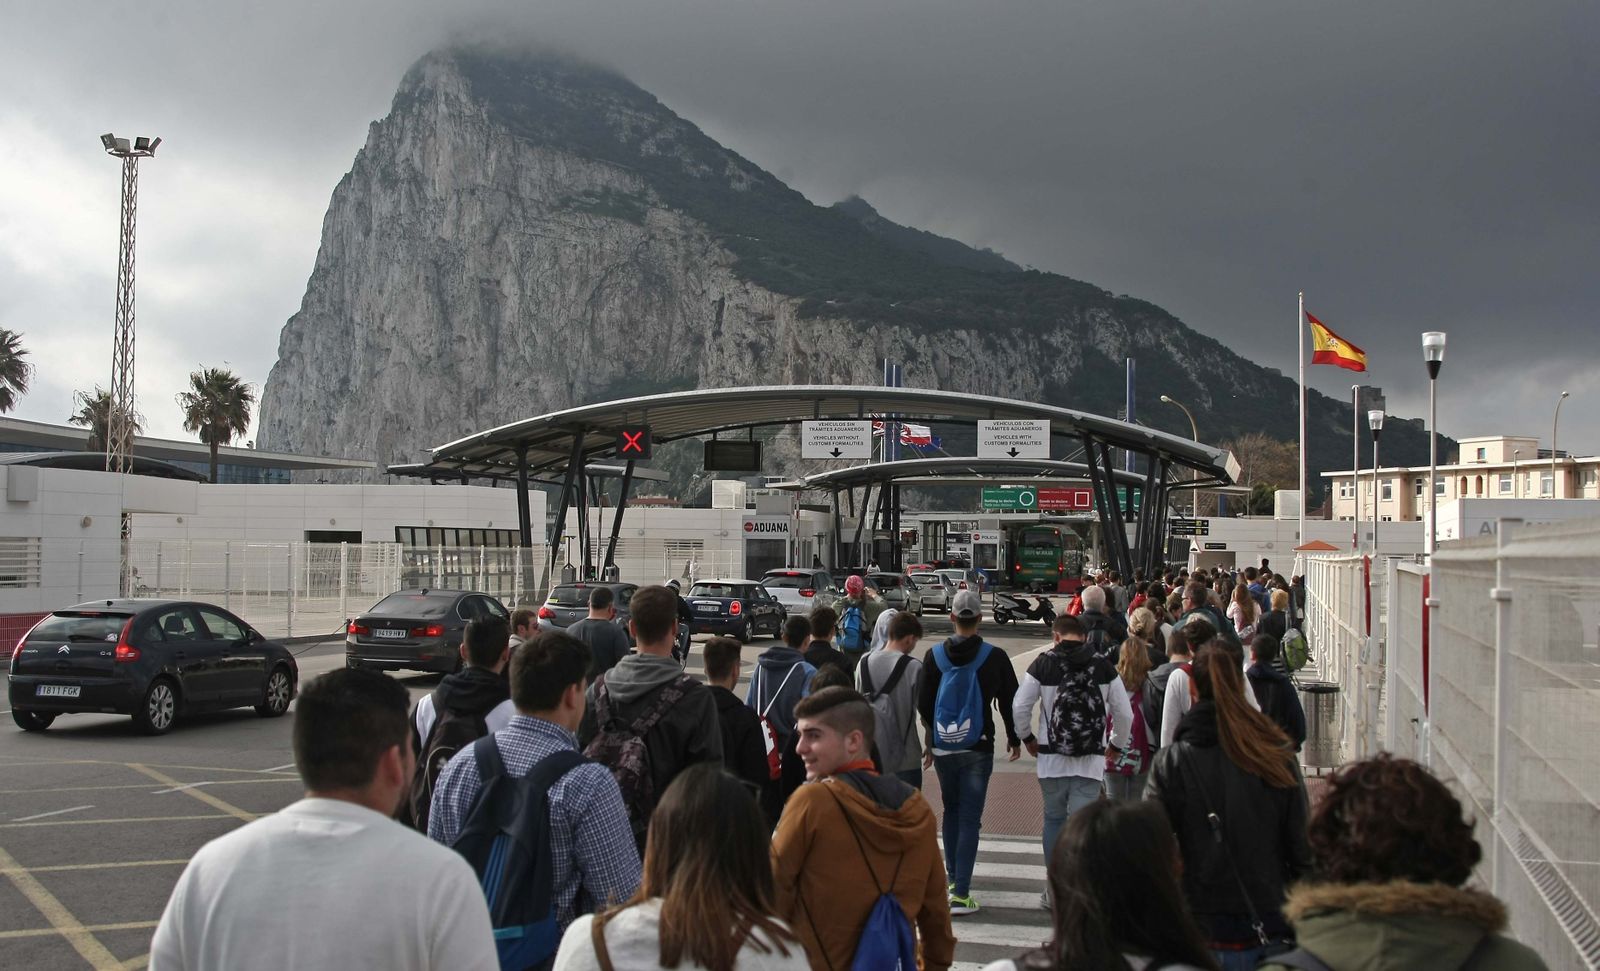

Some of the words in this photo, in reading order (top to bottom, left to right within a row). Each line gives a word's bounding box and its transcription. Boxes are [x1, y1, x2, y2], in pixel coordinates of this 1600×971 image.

[754, 522, 789, 532] ADUANA
[43, 686, 61, 695] 1811
[62, 687, 78, 695] FGK
